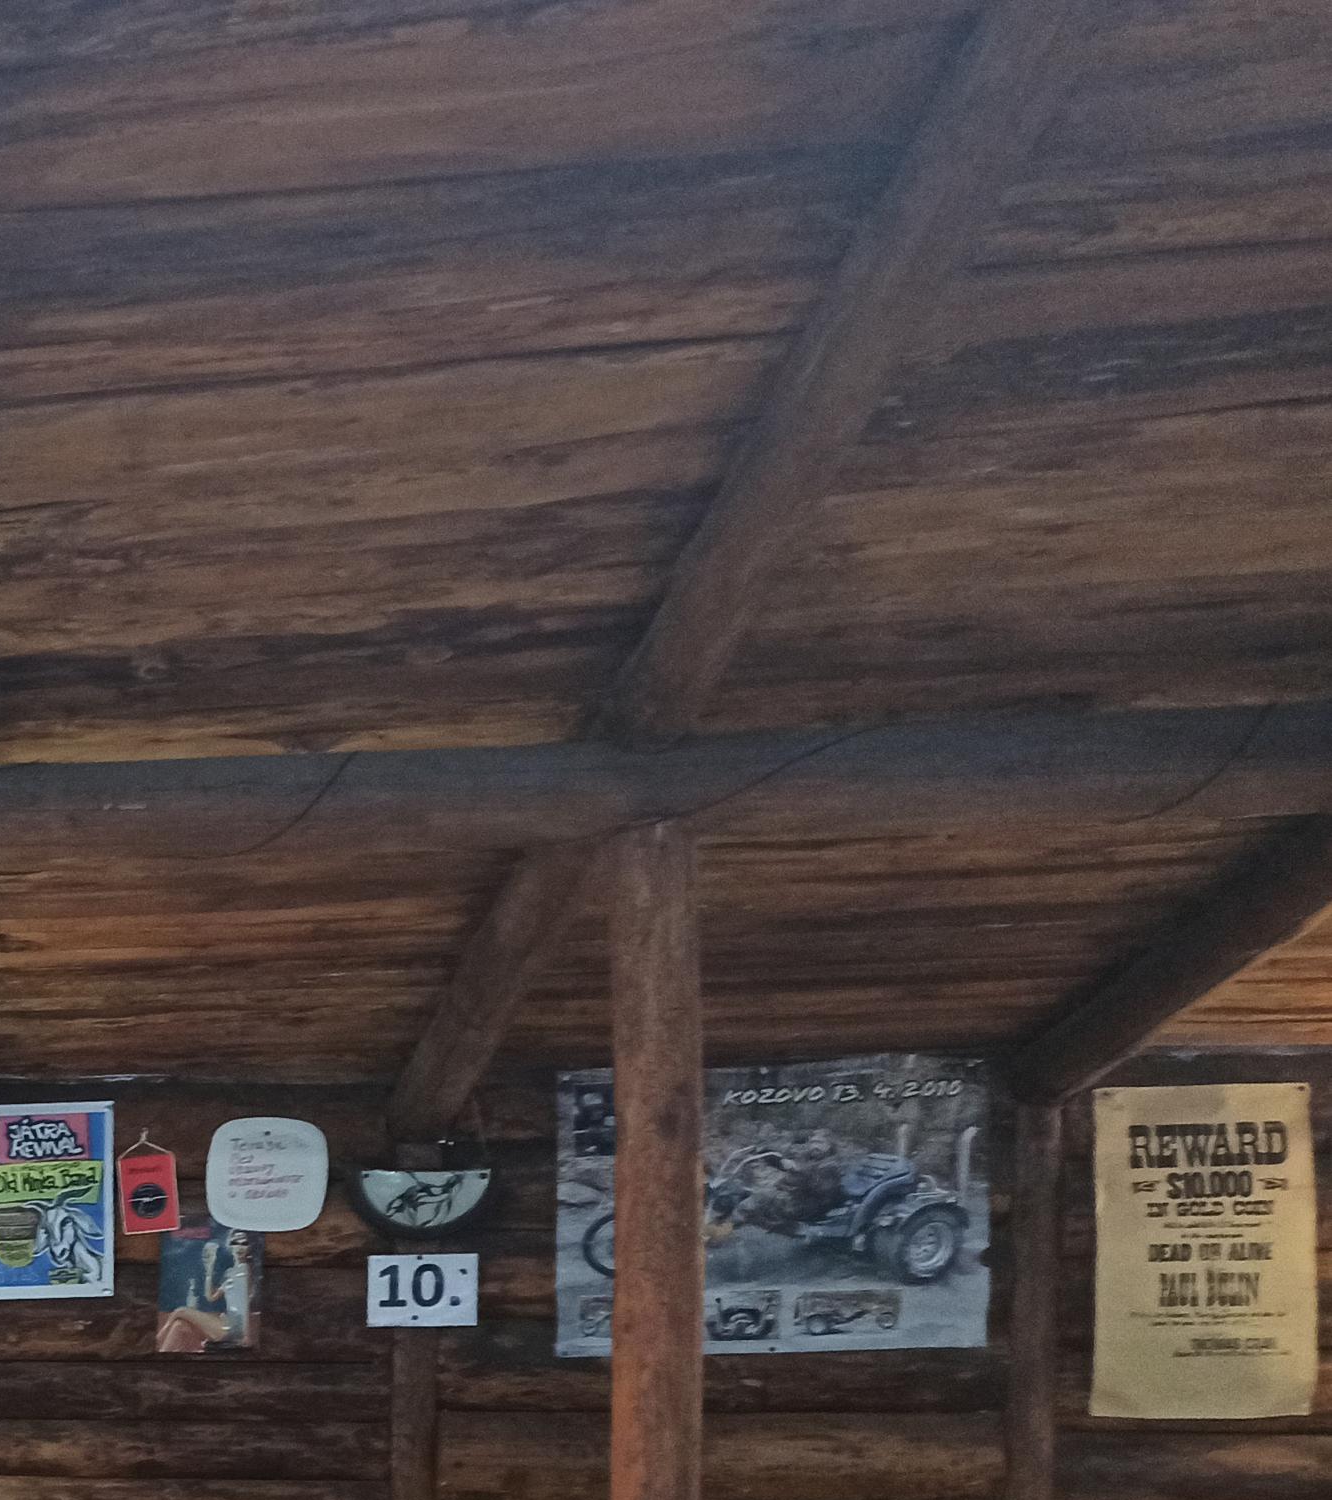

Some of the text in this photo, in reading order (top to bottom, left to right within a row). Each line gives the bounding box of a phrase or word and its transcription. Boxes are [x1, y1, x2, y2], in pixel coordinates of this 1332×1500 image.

[722, 1085, 825, 1106] KOZOVO
[900, 1079, 963, 1098] 2010
[1128, 1121, 1288, 1169] REWARD
[1148, 1243, 1193, 1263] DEAD
[378, 1263, 462, 1308] 10.
